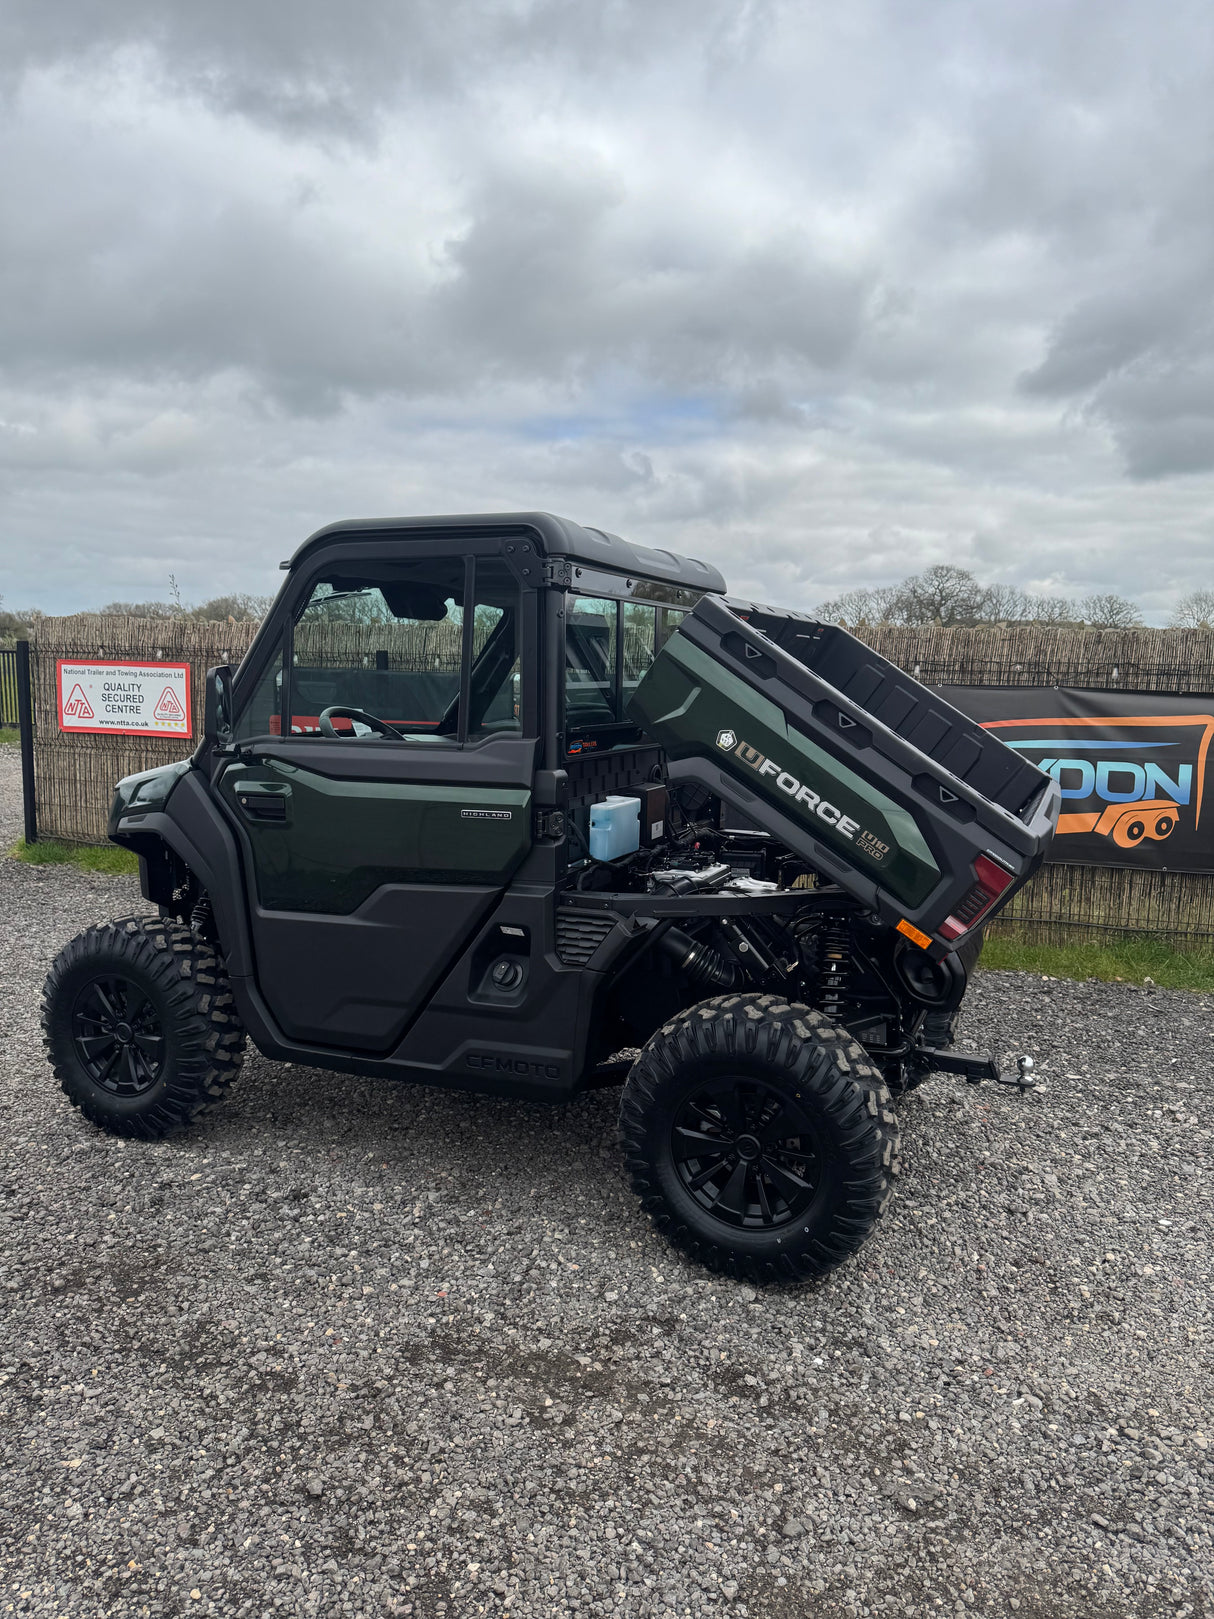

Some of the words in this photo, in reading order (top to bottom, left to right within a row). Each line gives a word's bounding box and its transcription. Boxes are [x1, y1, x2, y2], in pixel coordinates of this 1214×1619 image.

[118, 670, 138, 678] Towing
[139, 671, 173, 679] Association
[174, 671, 184, 679] Ltd
[103, 682, 142, 692] QUALITY
[101, 693, 145, 704] SECURED
[66, 699, 91, 717] NTTA
[105, 704, 142, 714] CENTRE
[99, 719, 149, 727] www.ntta.co.uk
[462, 811, 510, 819] HIGHLAND
[861, 830, 890, 854] U10
[855, 838, 885, 861] PRO
[466, 1055, 561, 1080] CFMOTO
